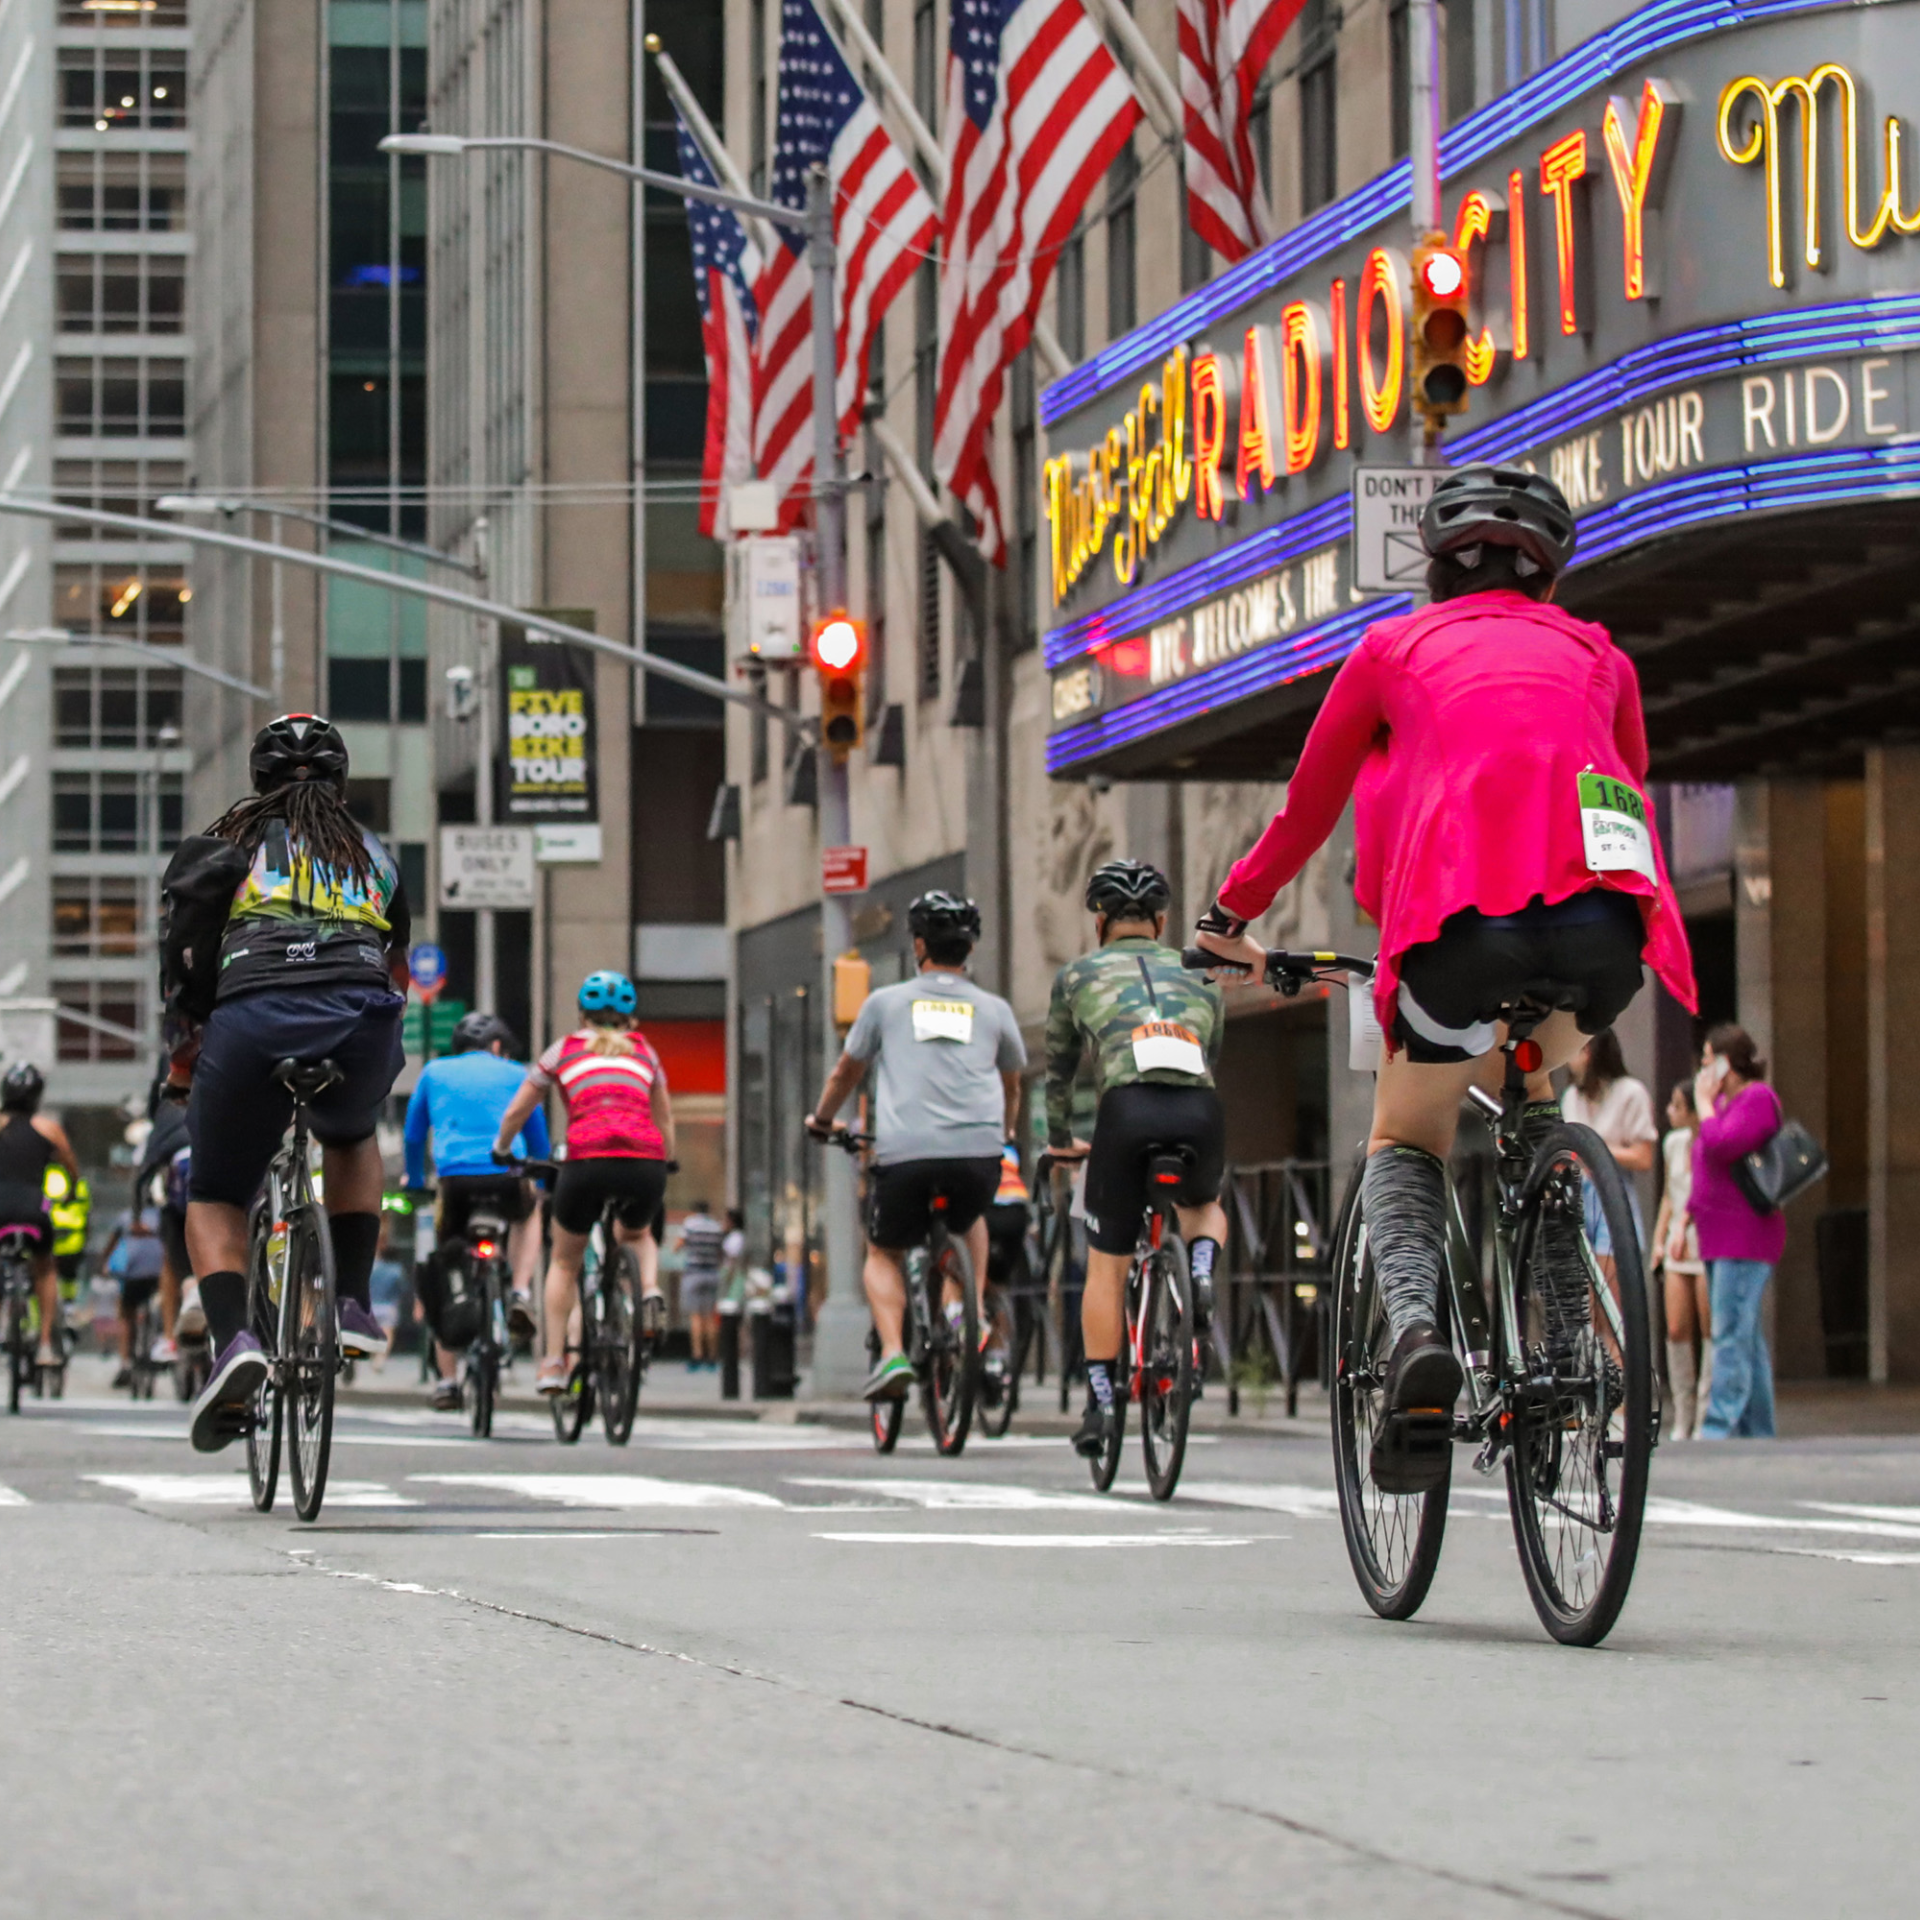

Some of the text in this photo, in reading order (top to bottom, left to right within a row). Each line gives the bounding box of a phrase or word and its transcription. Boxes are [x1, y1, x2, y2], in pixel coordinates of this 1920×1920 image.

[1191, 246, 1404, 521] RADIO
[1451, 77, 1666, 386] CITY
[1620, 390, 1705, 488] TOUR
[1742, 358, 1899, 453] RIDE
[1364, 476, 1424, 497] DON'T
[1192, 569, 1297, 668] WELCOMES
[1303, 548, 1340, 622] THE
[511, 690, 583, 715] FIVE
[510, 713, 587, 738] BORO
[511, 737, 584, 759] BIKE
[511, 757, 586, 784] TOUR
[1595, 780, 1645, 821] 168
[455, 834, 518, 852] BUSES
[462, 854, 512, 874] ONLY
